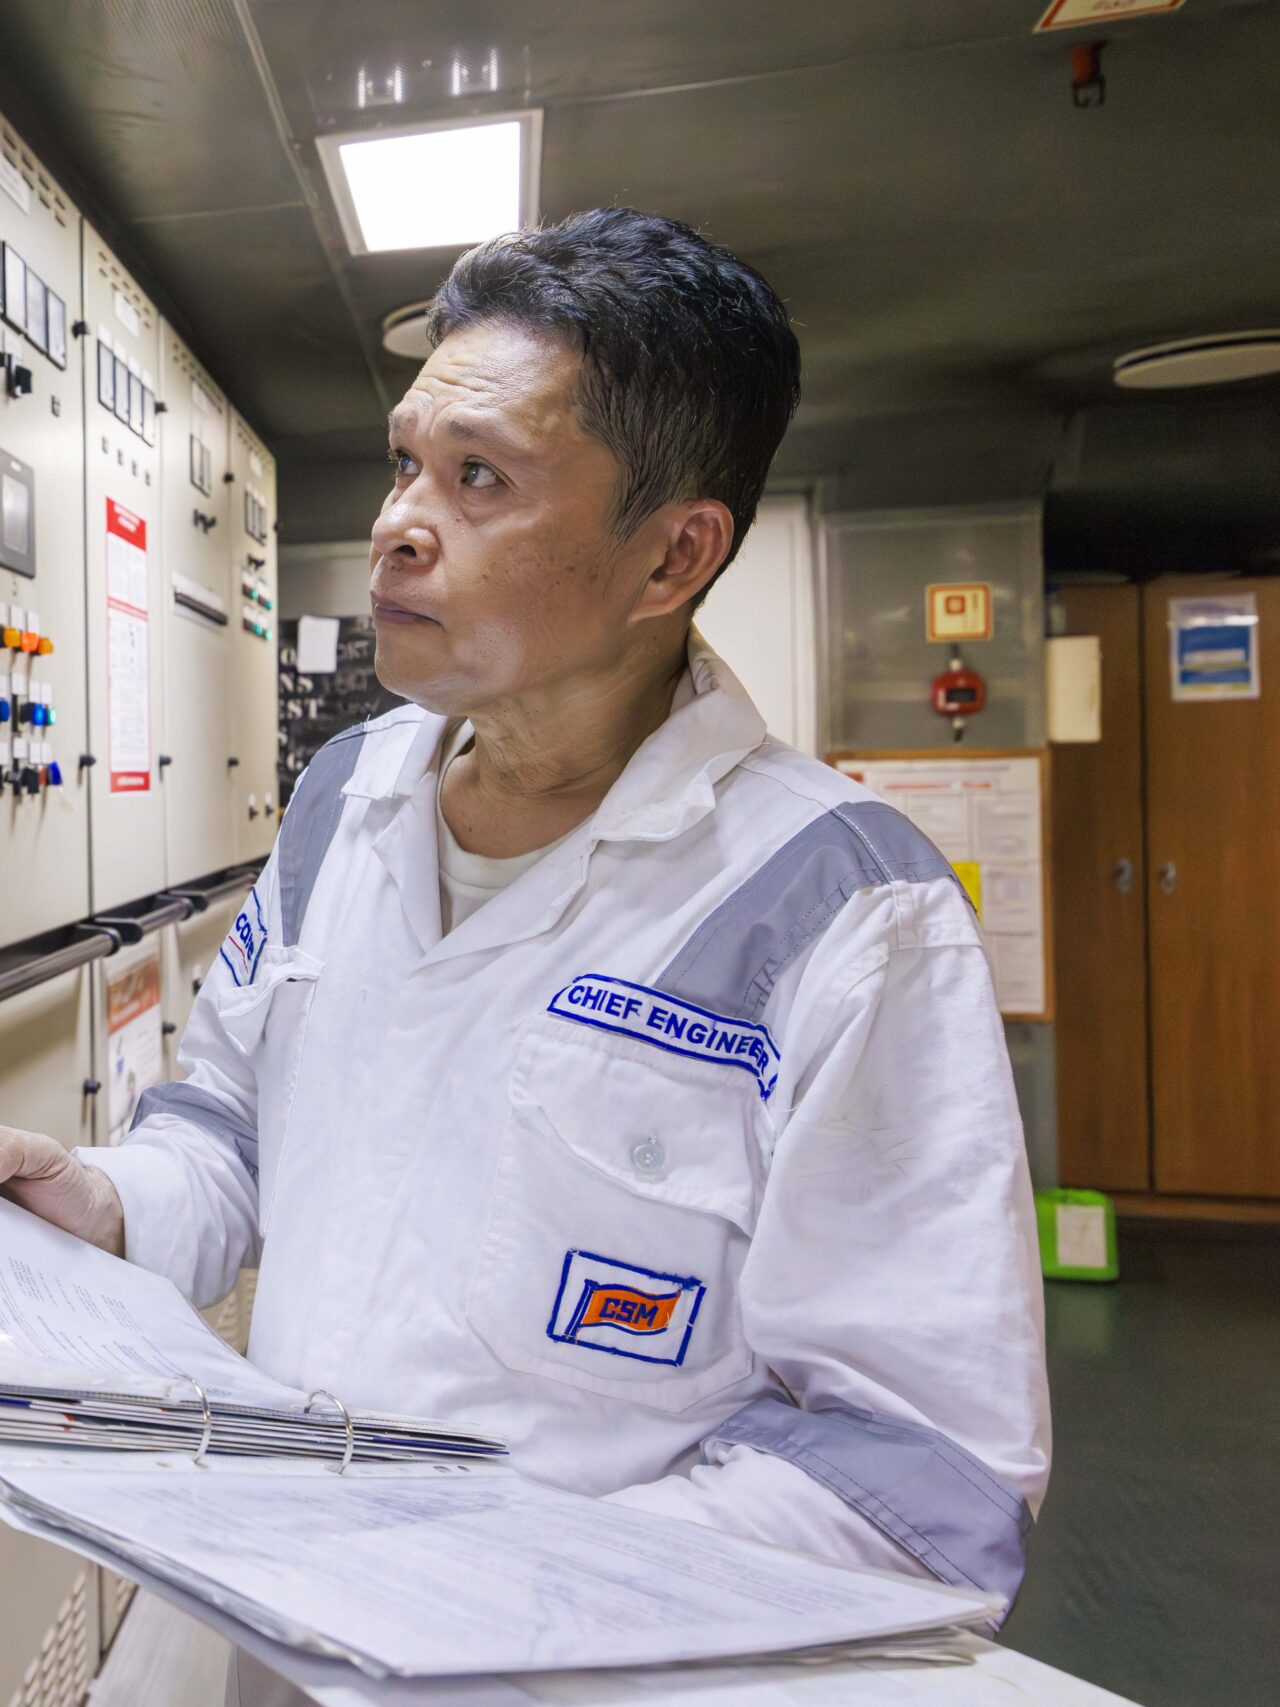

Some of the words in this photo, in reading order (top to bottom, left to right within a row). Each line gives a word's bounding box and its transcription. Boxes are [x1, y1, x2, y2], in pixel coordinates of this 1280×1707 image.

[567, 984, 643, 1019] CHIEF
[646, 1006, 769, 1075] ENGINEER
[598, 1297, 659, 1327] CSM
